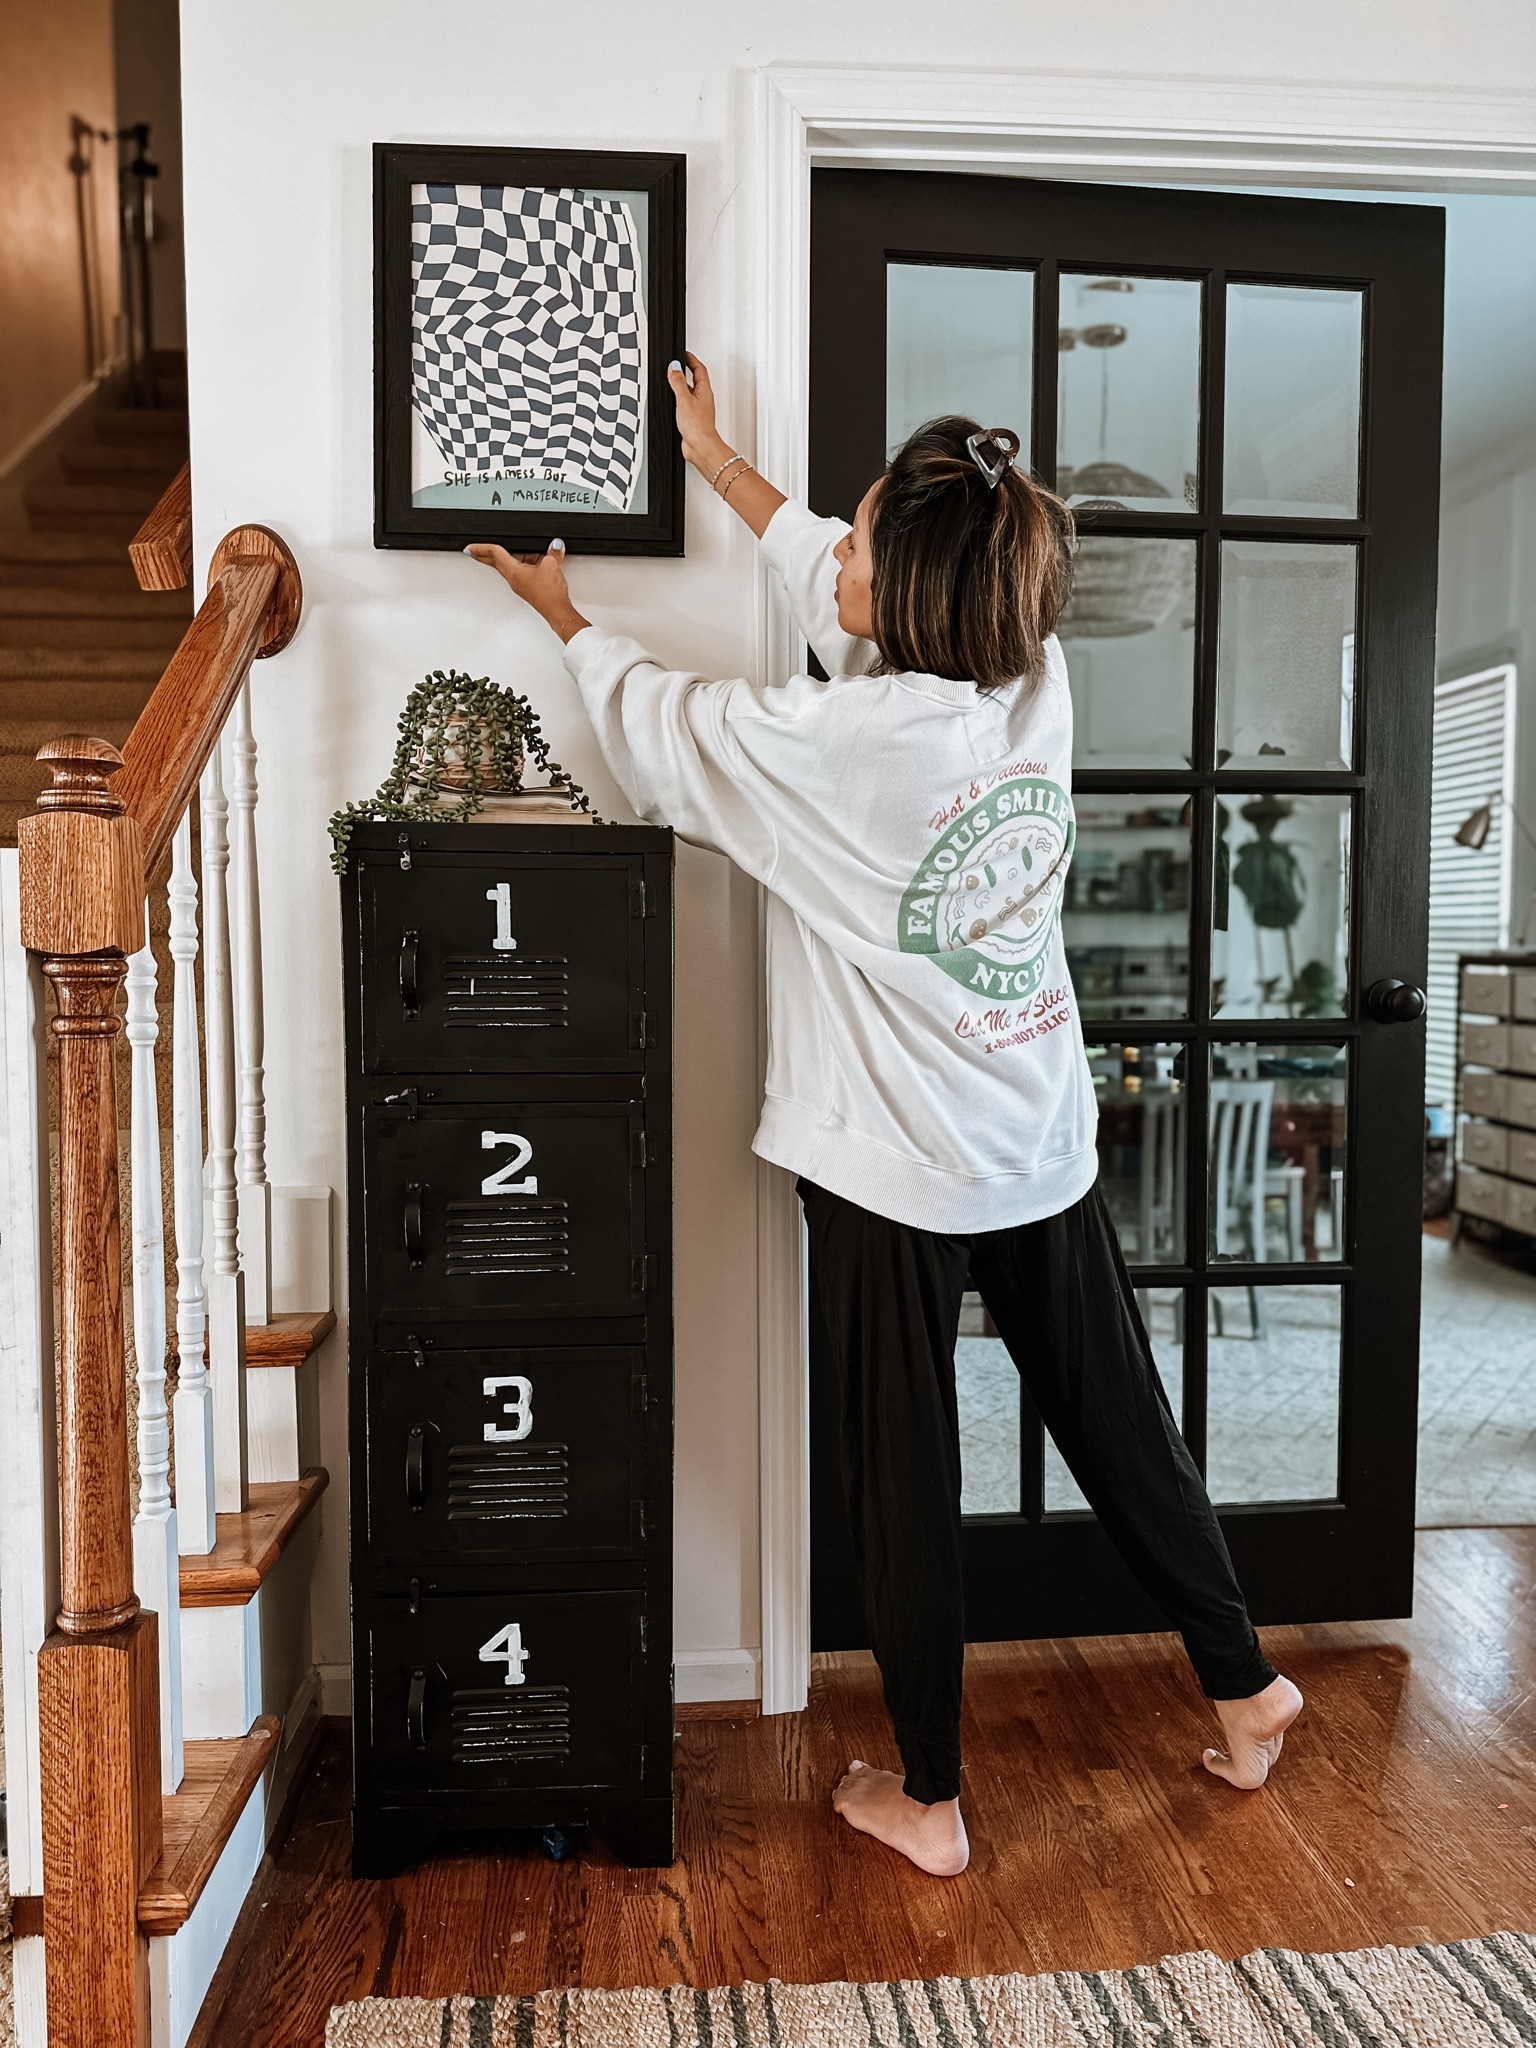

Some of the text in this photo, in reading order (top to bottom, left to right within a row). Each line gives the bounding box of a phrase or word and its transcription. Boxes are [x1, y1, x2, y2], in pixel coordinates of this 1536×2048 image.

[444, 468, 567, 487] SHE IS A MESS BUT
[491, 491, 502, 506] A
[928, 794, 965, 832] Hot
[969, 780, 981, 799] &
[907, 810, 991, 936] FAMOUS
[486, 883, 517, 949] 1
[969, 962, 1029, 994] NYC
[955, 985, 1068, 1039] Cut Me A Slice
[481, 1131, 538, 1196] 2
[483, 1376, 533, 1442] 3
[479, 1623, 530, 1685] 4
